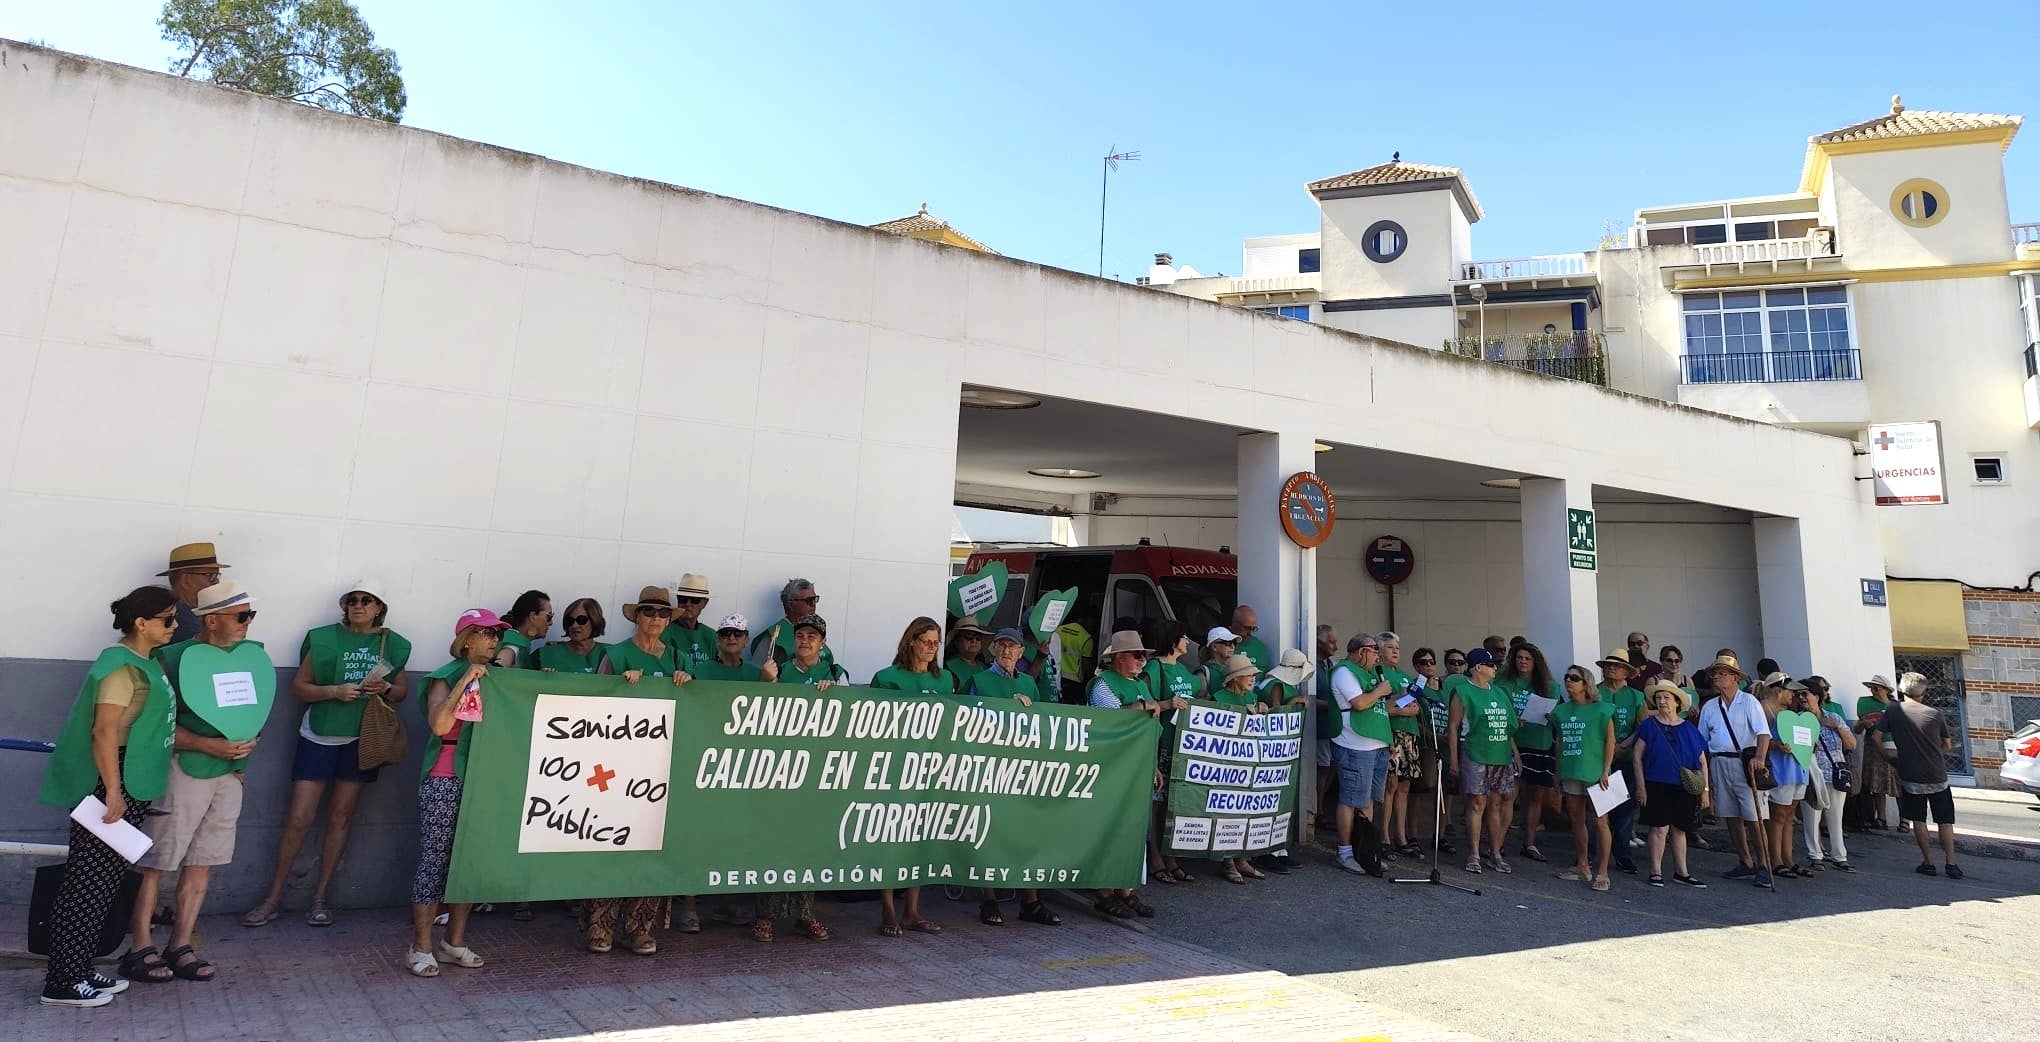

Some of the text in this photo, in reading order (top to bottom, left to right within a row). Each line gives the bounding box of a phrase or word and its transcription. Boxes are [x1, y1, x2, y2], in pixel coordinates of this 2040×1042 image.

[1877, 467, 1936, 479] URGENCIAS
[1305, 473, 1335, 513] AMBULANCIAS
[1289, 512, 1324, 521] URGENCIAS
[344, 671, 369, 680] PÚBLI
[546, 714, 668, 740] Sanidad
[723, 695, 1092, 752] SANIDAD 100X100 PÚBLICA Y DE
[1244, 717, 1265, 733] PASA
[1270, 716, 1283, 732] EN
[1289, 715, 1300, 731] LA
[1183, 733, 1254, 758] SANIDAD
[539, 757, 580, 781] 100
[625, 778, 667, 803] 100
[695, 747, 1100, 799] CALIDAD EN EL DEPARTAMENTO 22
[1188, 764, 1290, 785] CUANDO FALTAN
[1208, 792, 1279, 811] RECURSOS?
[526, 795, 631, 846] Pública
[839, 801, 991, 850] (TORREVIEJA)
[709, 864, 1081, 886] DEROGACIÓN DE LA LEY 15/97
